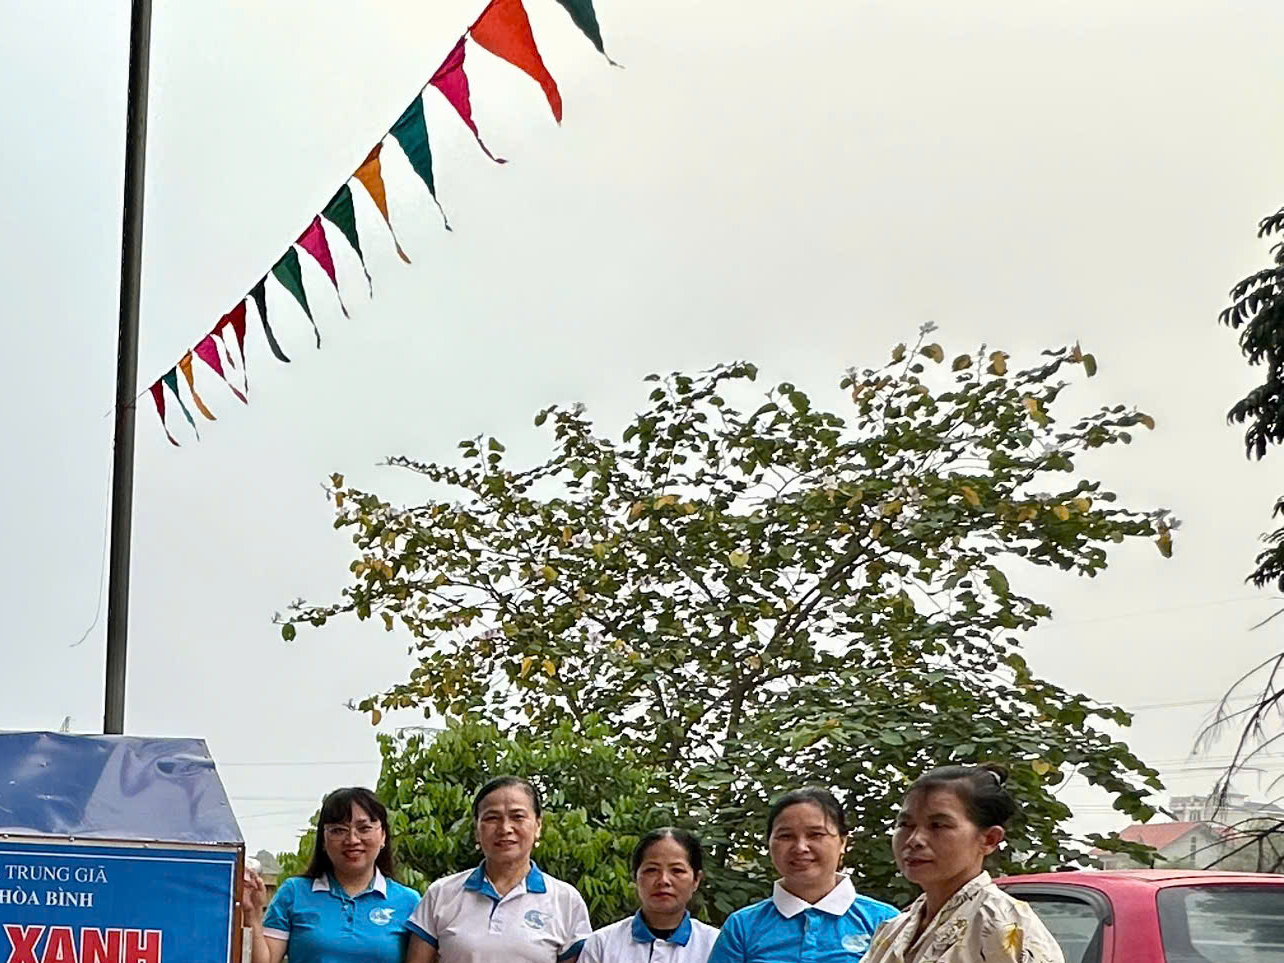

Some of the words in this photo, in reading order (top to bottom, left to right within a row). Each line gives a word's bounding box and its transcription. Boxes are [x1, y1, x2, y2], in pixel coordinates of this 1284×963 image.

[5, 864, 70, 882] TRUNG
[75, 865, 108, 883] GIÃ
[46, 887, 94, 907] BÌNH
